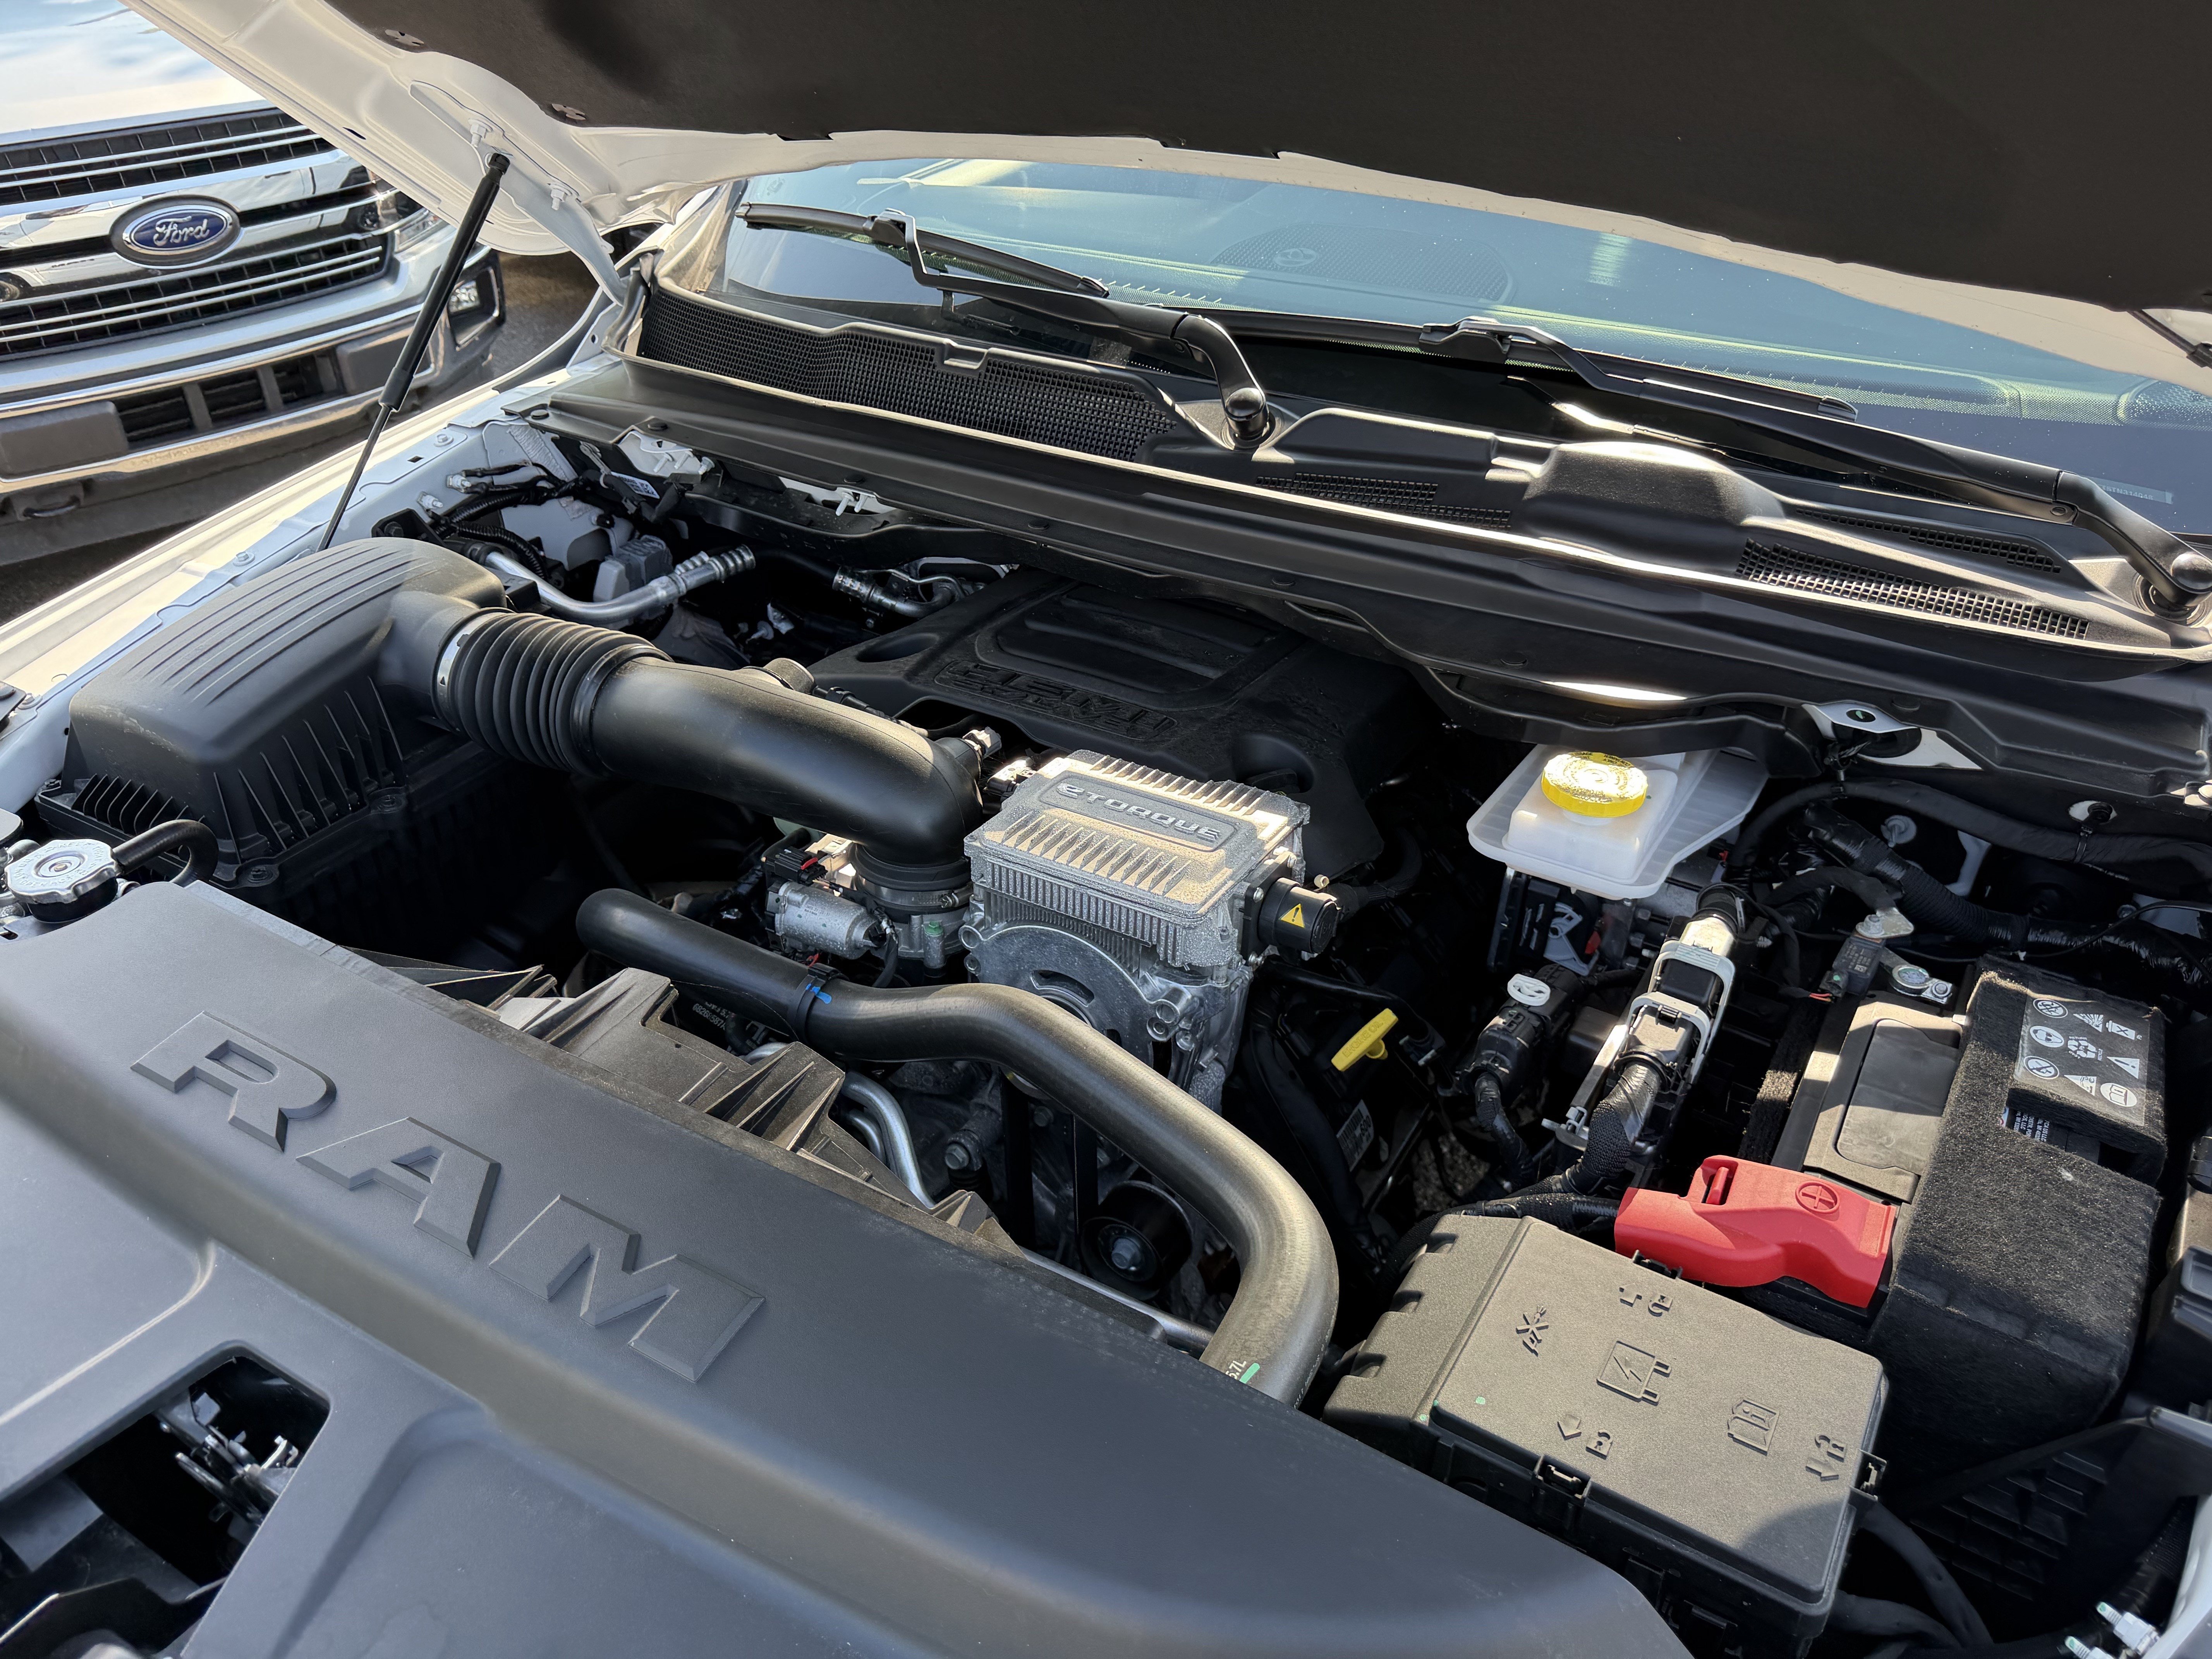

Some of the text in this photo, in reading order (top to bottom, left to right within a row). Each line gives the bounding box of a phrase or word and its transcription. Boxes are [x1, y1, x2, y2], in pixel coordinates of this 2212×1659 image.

[153, 215, 210, 246] Ford
[946, 659, 1172, 730] HEMI
[1342, 1021, 1384, 1058] ENGINE OIL
[131, 1010, 766, 1383] RAM
[1225, 1360, 1247, 1379] 5.7L
